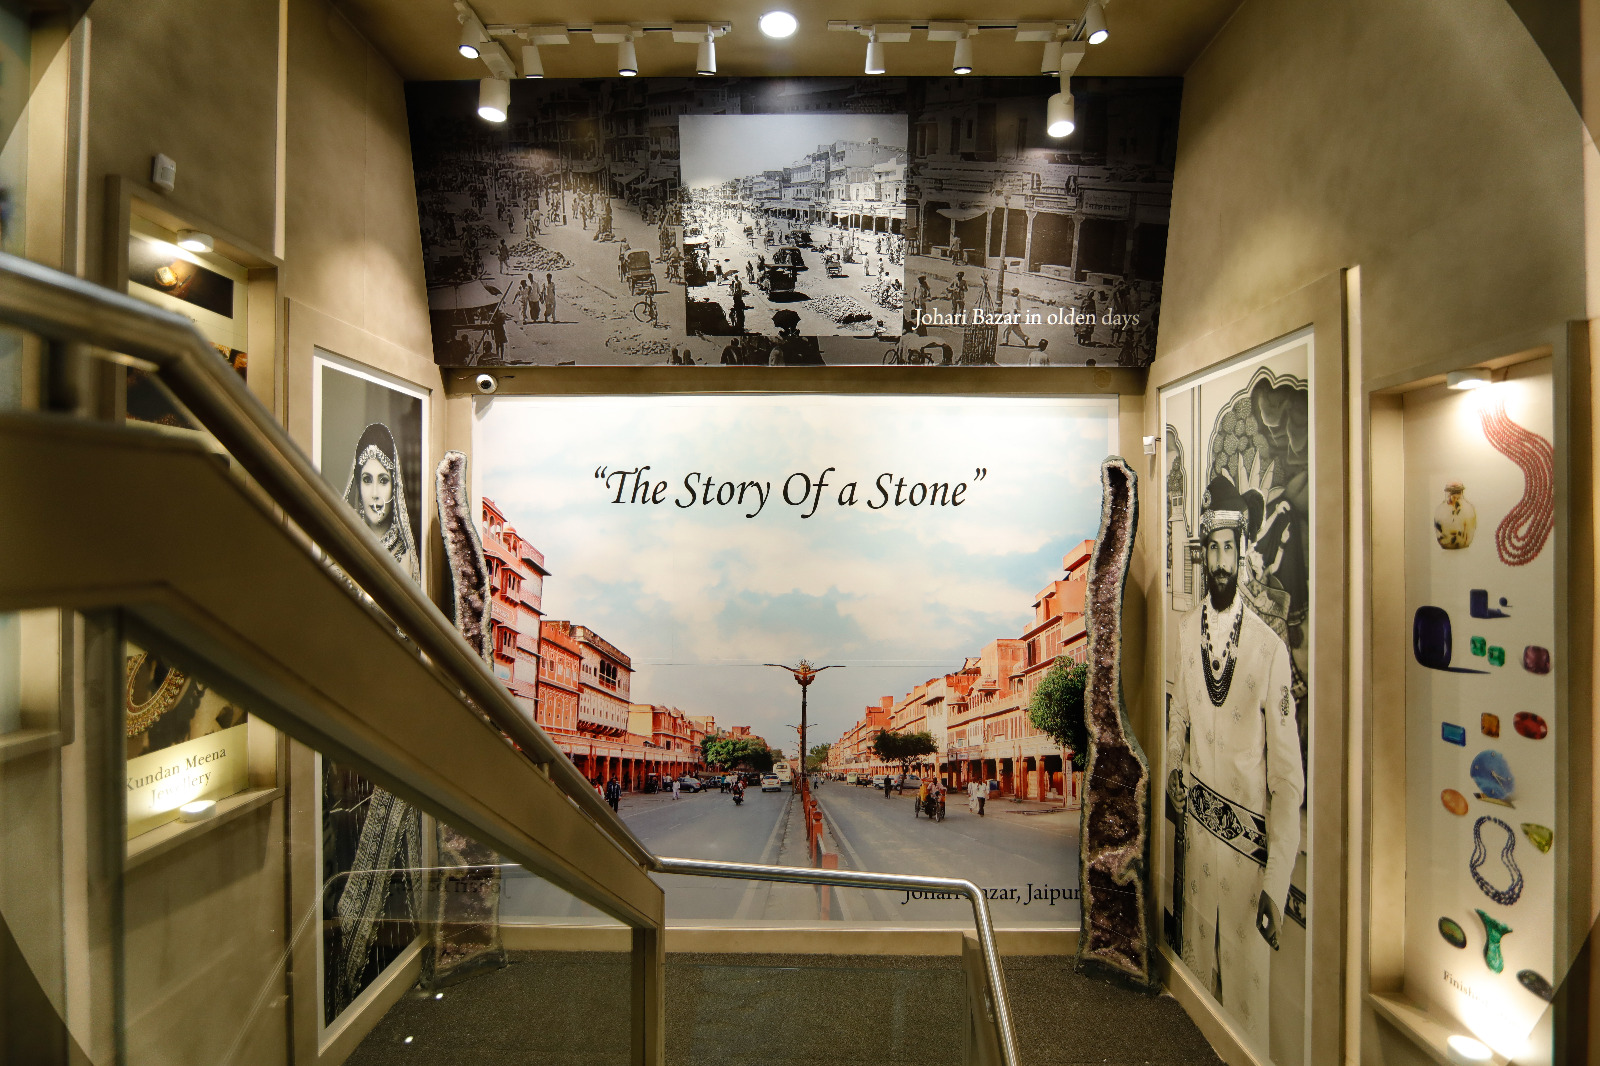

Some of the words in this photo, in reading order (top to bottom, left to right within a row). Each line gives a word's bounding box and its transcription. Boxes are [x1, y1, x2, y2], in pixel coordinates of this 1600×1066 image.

[912, 308, 967, 331] Johari
[972, 309, 1021, 326] Bazar
[1026, 309, 1042, 325] in
[1047, 308, 1096, 326] olden
[1101, 308, 1140, 331] days
[595, 465, 668, 505] “The
[675, 471, 771, 519] Story
[782, 467, 836, 519] Of
[837, 480, 858, 506] a
[867, 467, 987, 510] Stone”
[126, 766, 180, 791] Kundan
[185, 748, 227, 771] Meena
[149, 771, 212, 809] Jellery
[964, 888, 1021, 904] zar,
[1443, 969, 1489, 1009] Finish
